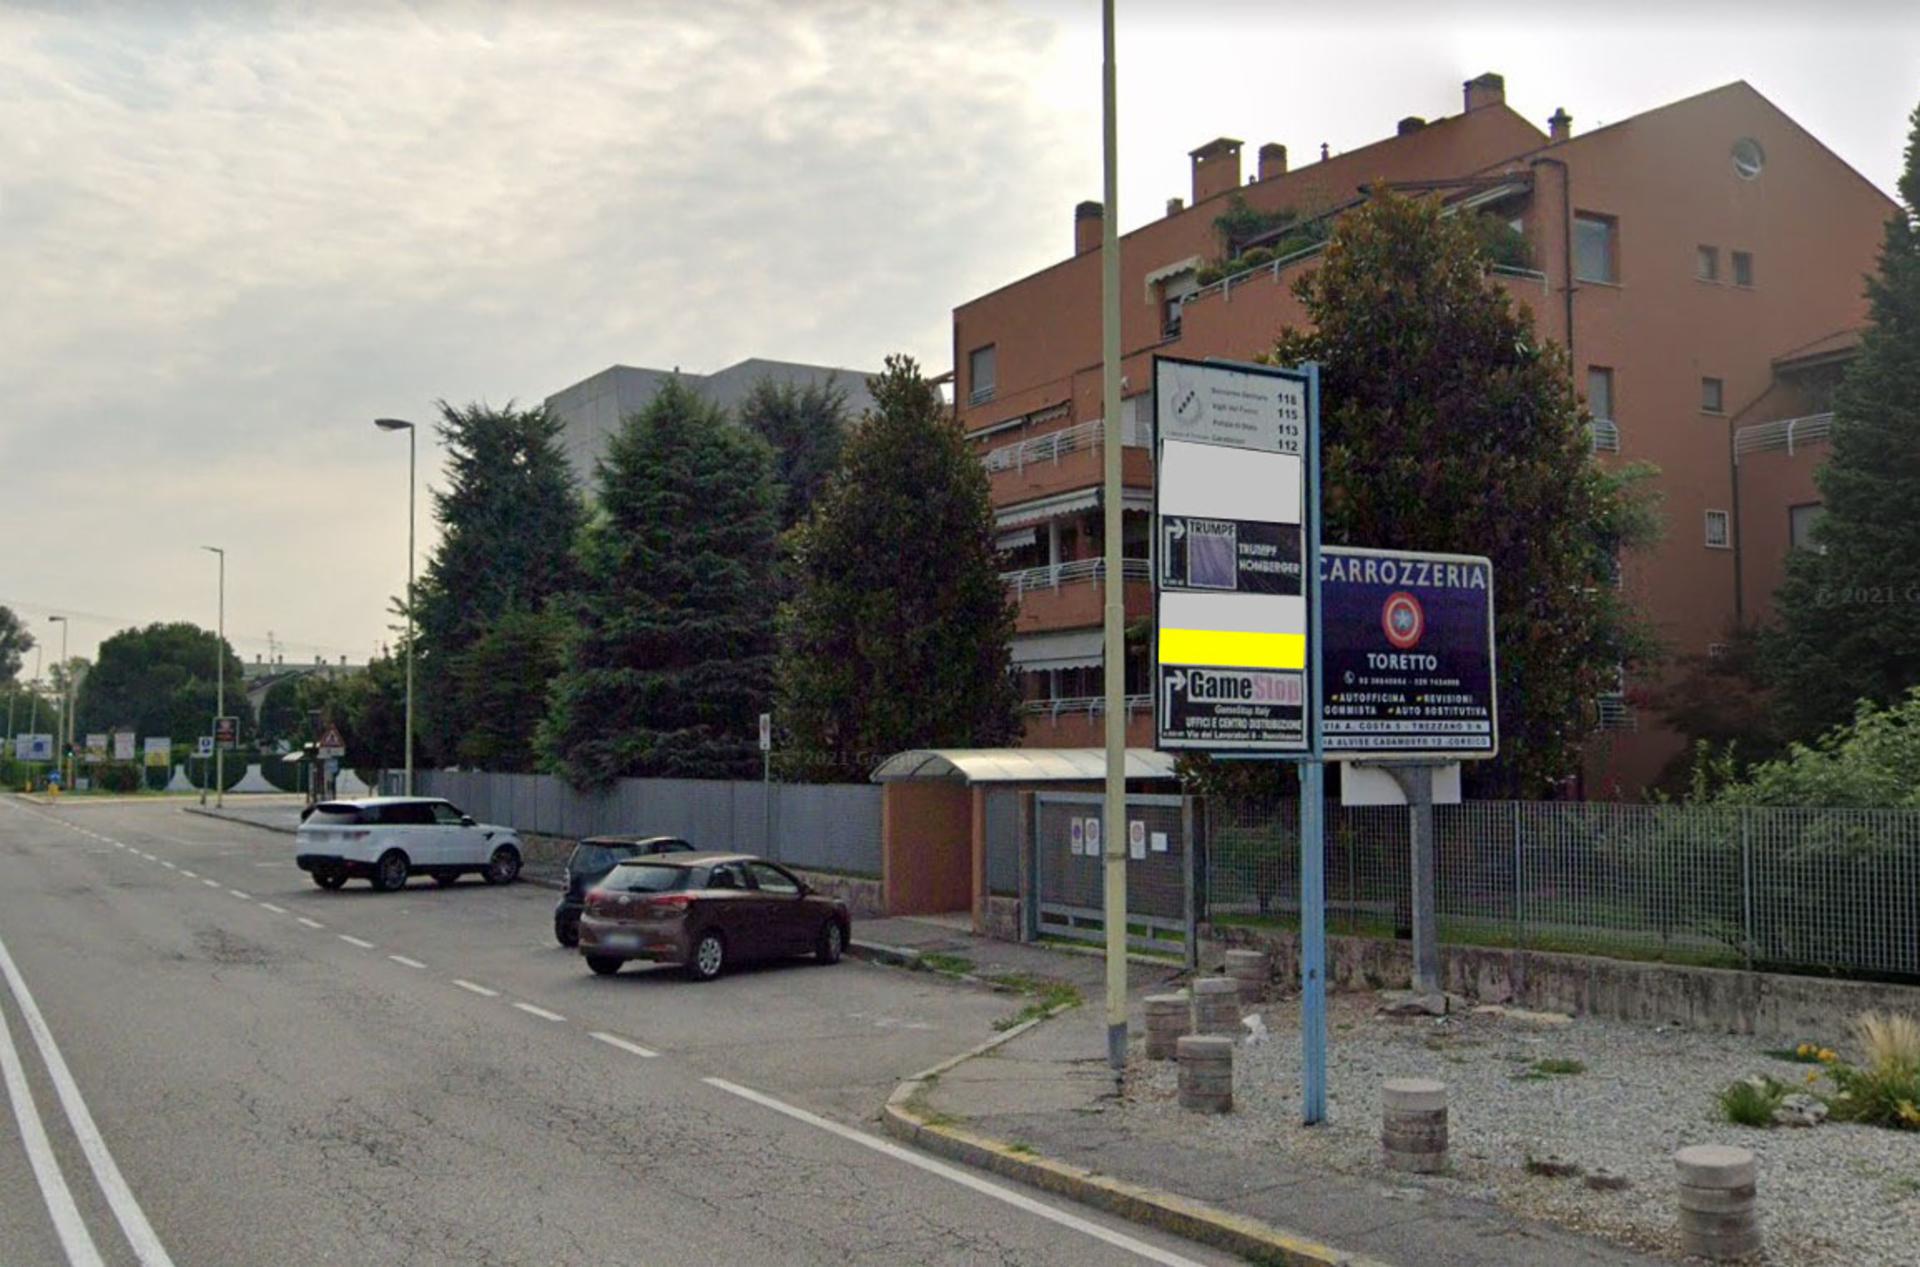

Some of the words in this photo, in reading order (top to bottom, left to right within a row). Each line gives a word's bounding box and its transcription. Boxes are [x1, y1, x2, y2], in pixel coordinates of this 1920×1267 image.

[1277, 408, 1298, 420] 115
[1278, 423, 1298, 436] 113
[1278, 439, 1298, 451] 112
[1190, 521, 1234, 536] TRUMPF
[1238, 543, 1278, 557] TRUMPF
[1320, 556, 1486, 590] CARROZZERIA
[1366, 653, 1438, 671] TORETTO
[1190, 671, 1300, 703] GameStop
[1339, 692, 1406, 703] AUTOFFICINA
[1424, 693, 1474, 704] REVISIONI
[1323, 704, 1377, 716] GOMMISTA
[1395, 705, 1422, 716] AUTO
[1424, 706, 1488, 717] SOSTITUTIVA
